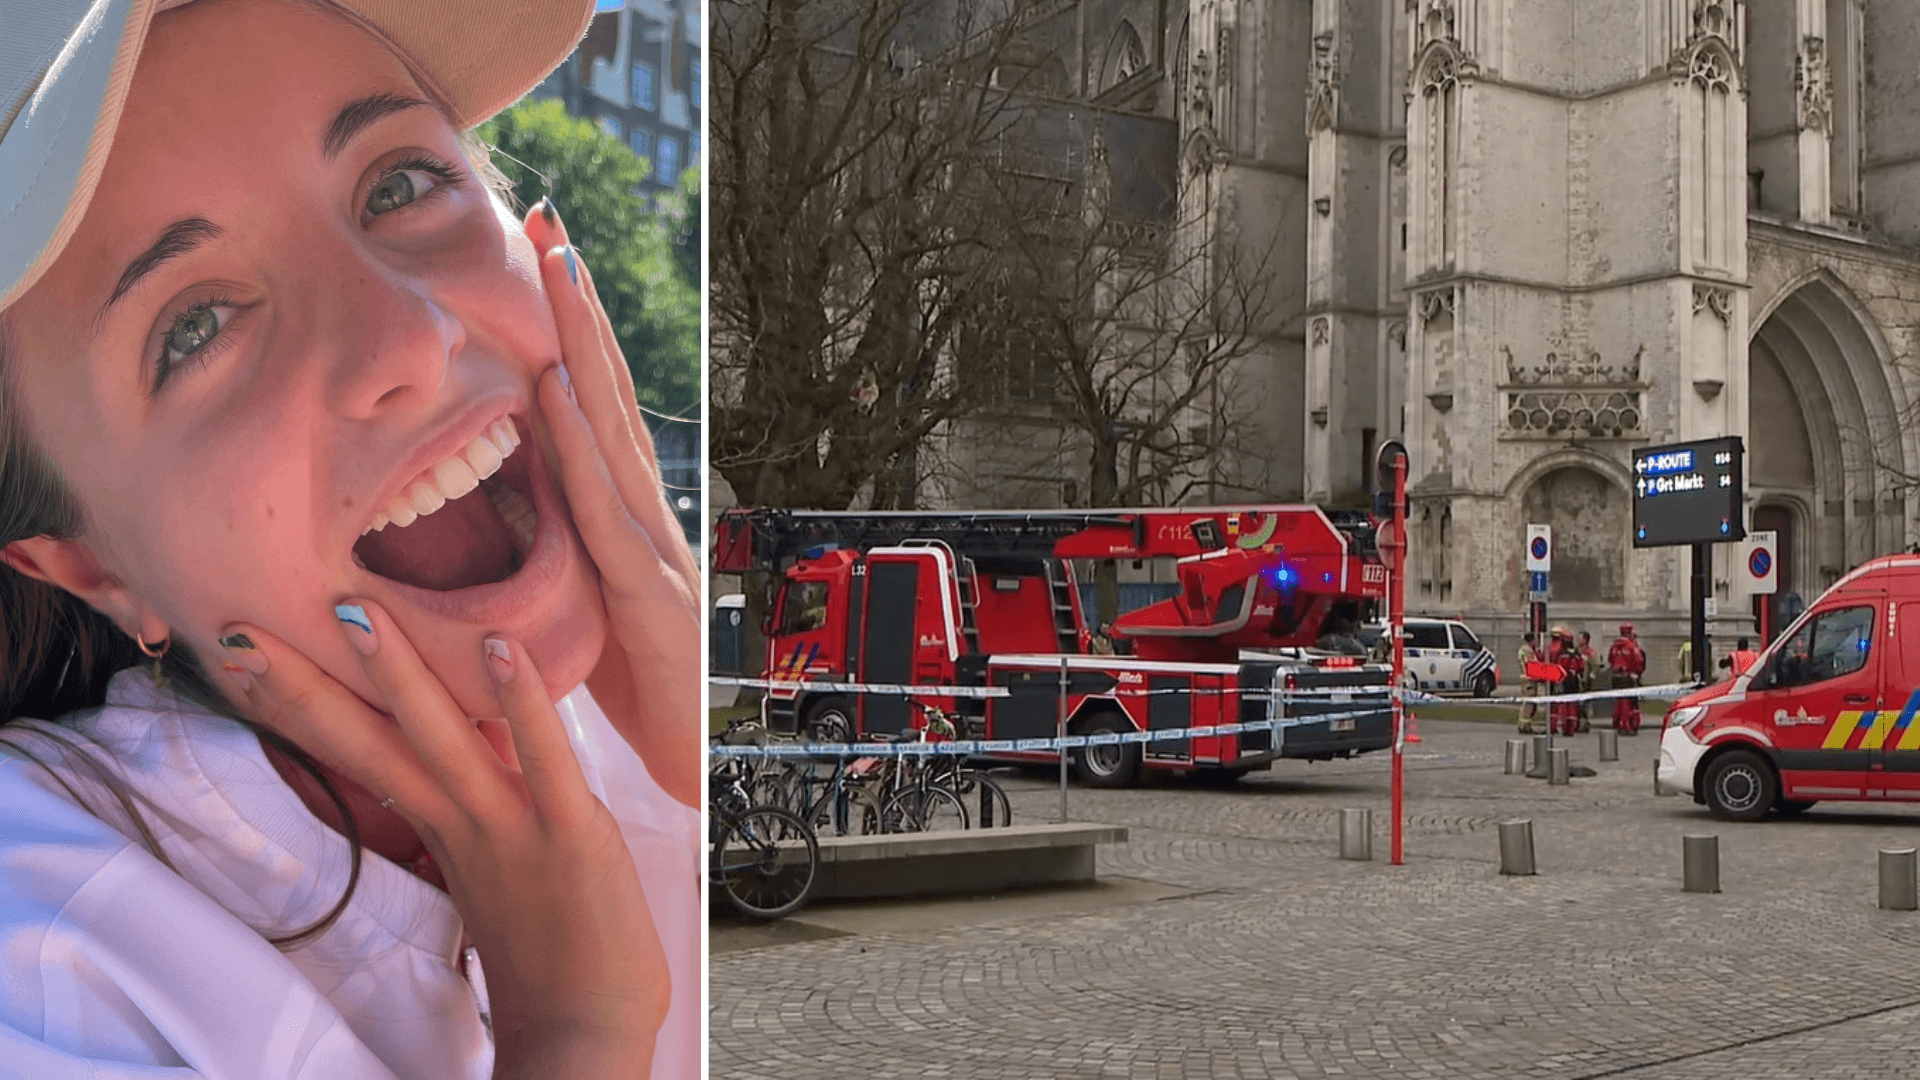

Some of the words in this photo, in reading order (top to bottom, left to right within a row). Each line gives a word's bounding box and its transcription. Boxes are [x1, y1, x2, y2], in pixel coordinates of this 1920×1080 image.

[1647, 451, 1691, 472] P-ROUTE
[1647, 479, 1655, 493] P
[1656, 476, 1674, 493] Grt
[1674, 473, 1704, 491] Markt
[1168, 524, 1193, 540] 112
